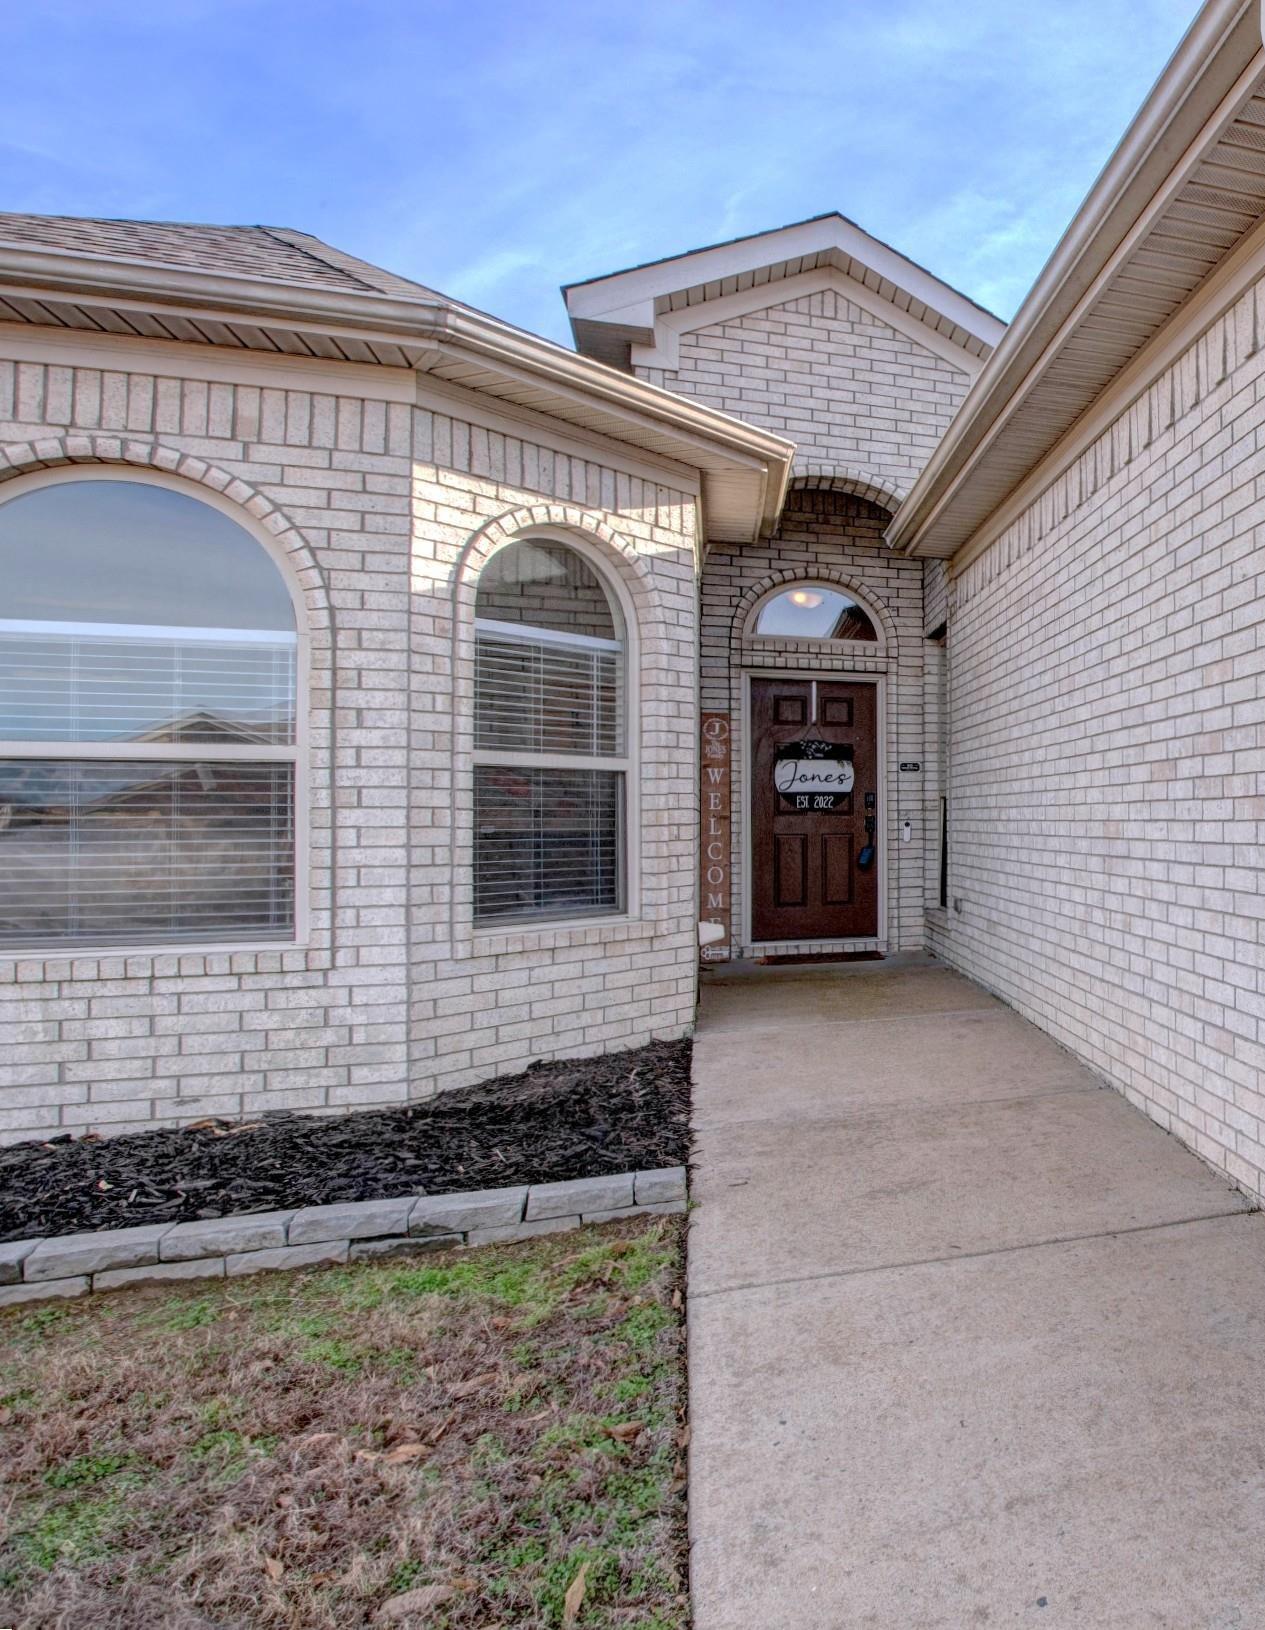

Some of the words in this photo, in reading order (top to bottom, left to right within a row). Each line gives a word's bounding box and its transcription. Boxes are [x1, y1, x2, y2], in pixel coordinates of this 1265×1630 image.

[709, 722, 721, 736] J
[778, 760, 852, 792] Jones
[813, 795, 835, 809] 2022
